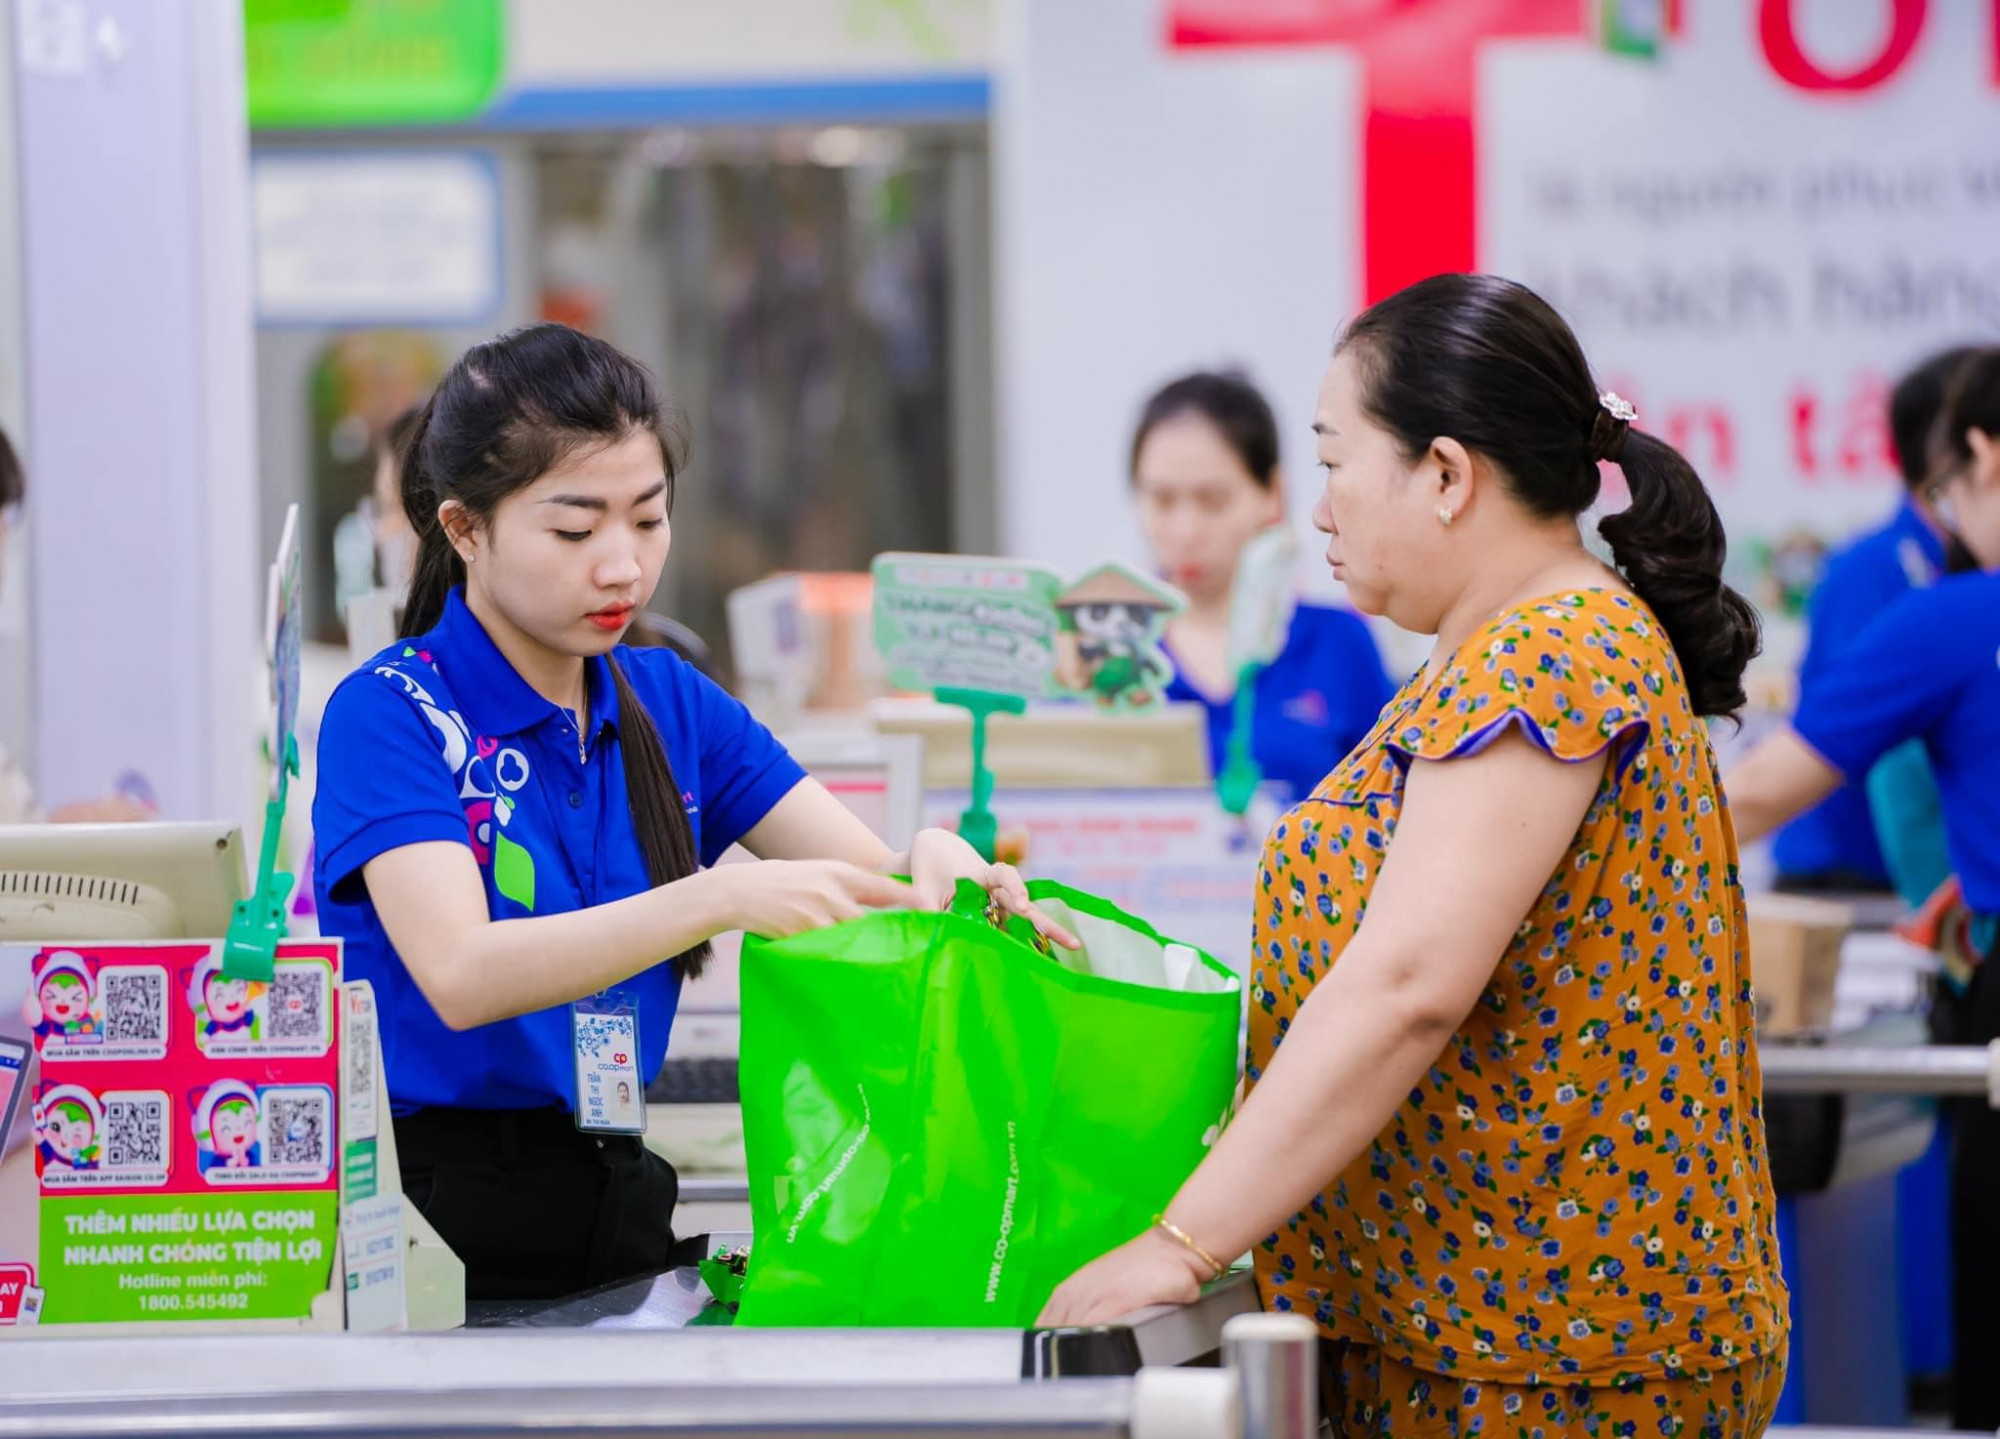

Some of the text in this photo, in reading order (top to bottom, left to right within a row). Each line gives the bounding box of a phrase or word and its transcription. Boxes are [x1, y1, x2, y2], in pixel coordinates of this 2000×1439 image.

[64, 1210, 126, 1235] THÊM
[203, 1209, 247, 1236] LỰA
[252, 1210, 315, 1235] CHỌN
[64, 1237, 322, 1266] NHANH CHÓNG TIỆN LỢI
[119, 1273, 182, 1290] Hotline
[139, 1293, 249, 1312] 1800.545492
